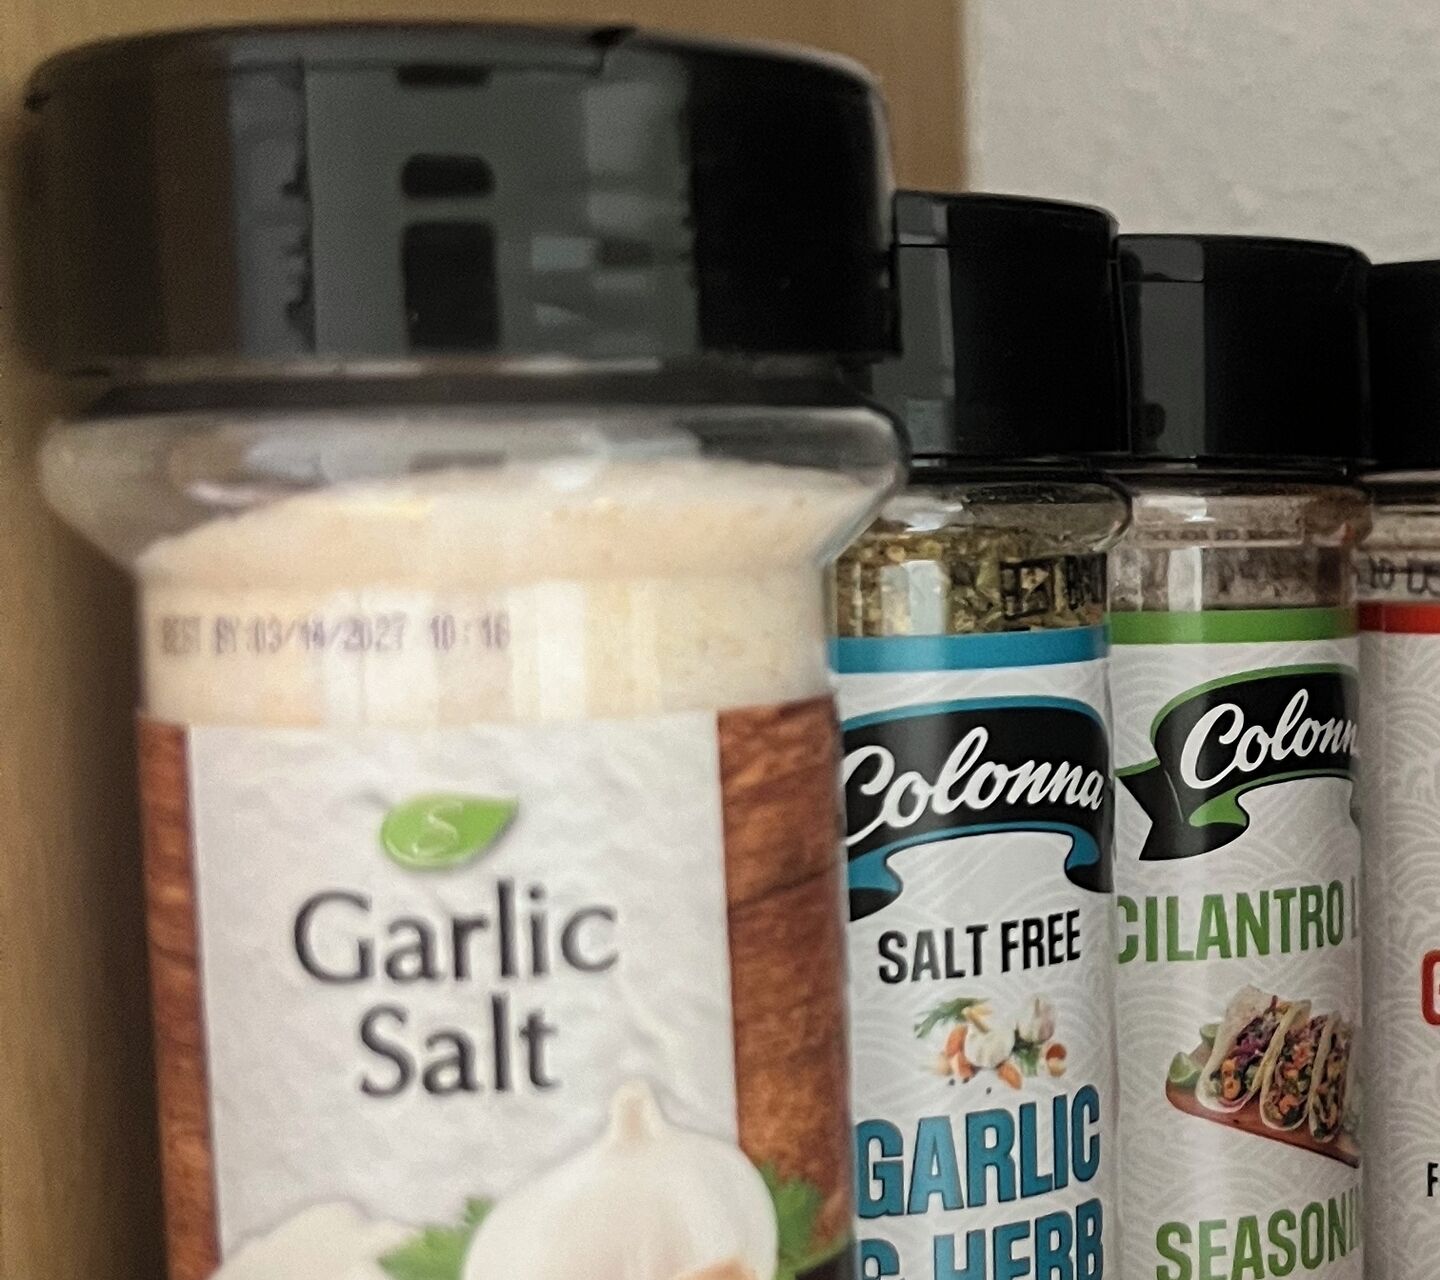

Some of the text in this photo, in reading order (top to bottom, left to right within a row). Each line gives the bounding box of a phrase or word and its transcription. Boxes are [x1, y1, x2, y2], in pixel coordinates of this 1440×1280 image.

[842, 726, 1104, 847] Colonna
[293, 877, 619, 986] Garlic
[878, 909, 1081, 984] SALT FREE
[1117, 879, 1344, 965] CILANTRO
[359, 992, 559, 1098] Salt
[854, 1084, 1100, 1218] GARLIC
